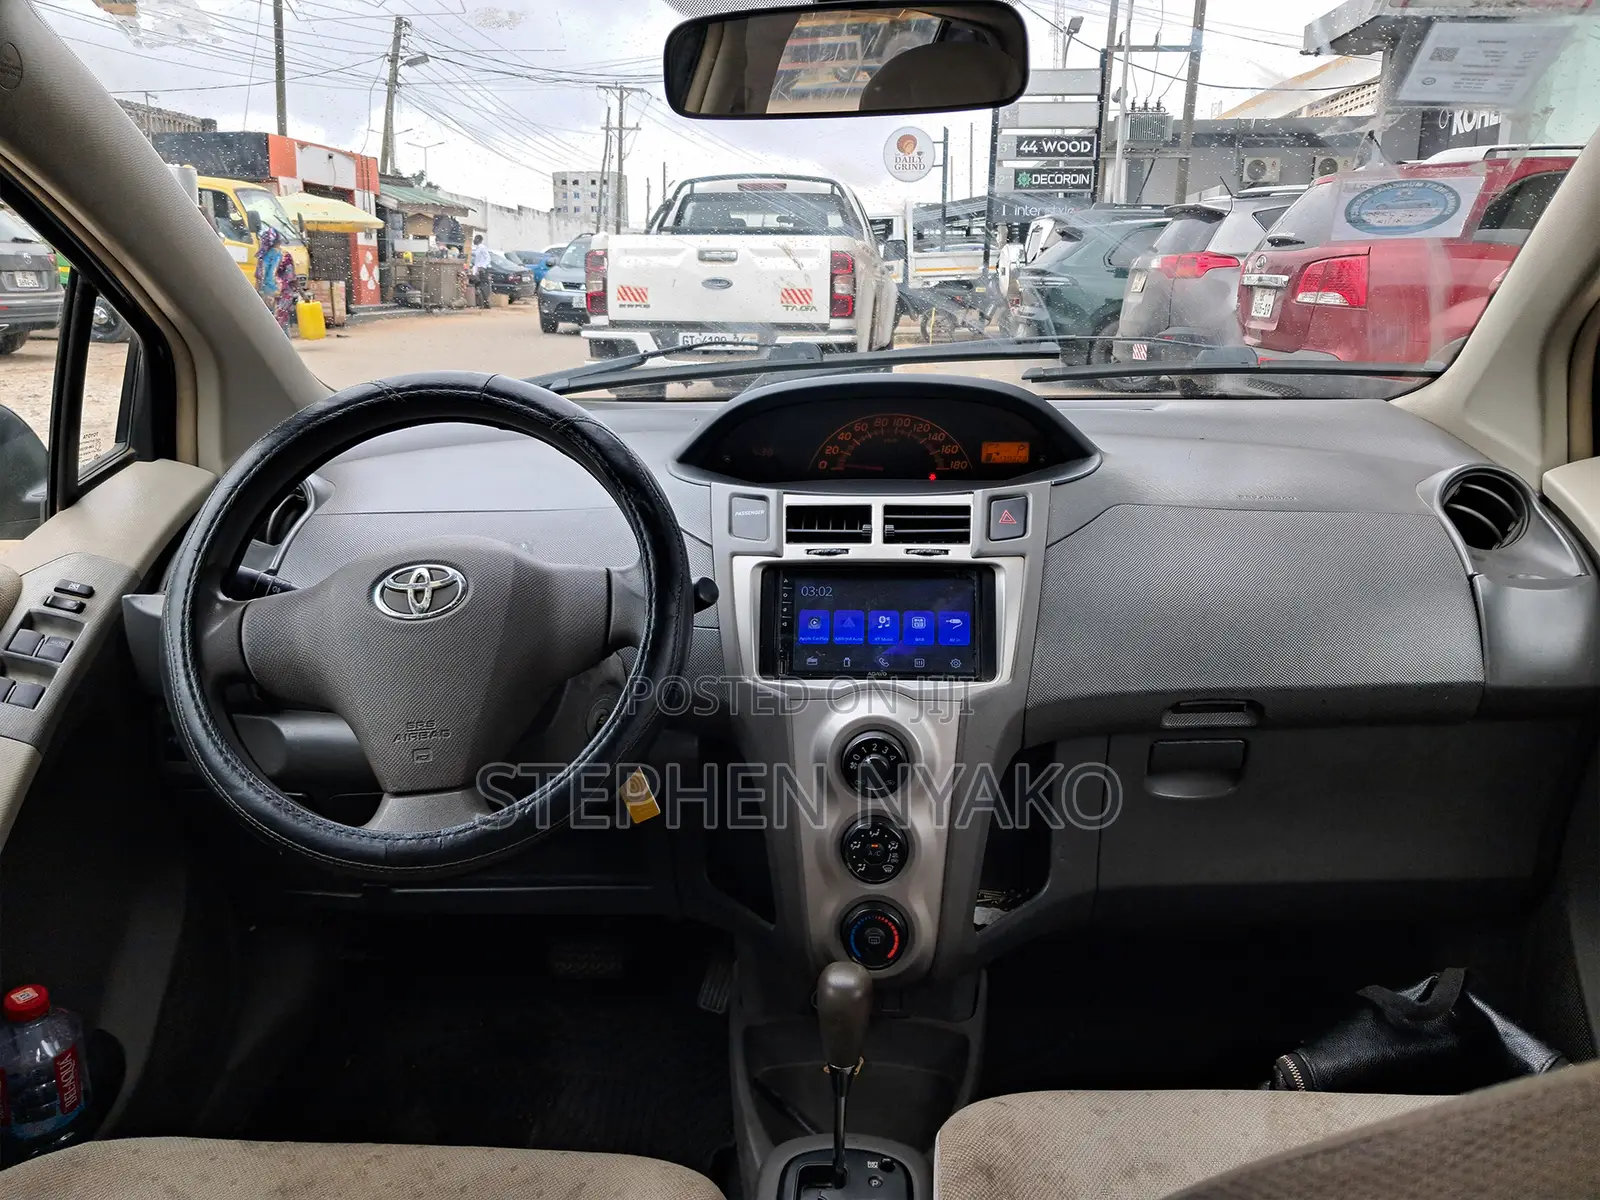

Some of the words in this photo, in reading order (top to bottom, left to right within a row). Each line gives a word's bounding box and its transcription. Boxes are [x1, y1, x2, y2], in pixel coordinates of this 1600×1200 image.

[1020, 140, 1038, 153] 44
[1042, 140, 1091, 153] WOOD
[894, 156, 923, 164] DAILY
[1032, 173, 1090, 185] DECORDIN
[874, 418, 888, 426] 80
[893, 418, 911, 426] 100
[854, 422, 868, 431] 60
[913, 424, 930, 432] 120
[838, 432, 851, 440] 40
[928, 432, 946, 441] 140
[825, 446, 839, 454] 20
[941, 445, 959, 453] 160
[818, 460, 827, 469] 0
[950, 461, 968, 469] 180
[801, 586, 833, 597] 03:02
[872, 743, 877, 751] 2
[882, 746, 889, 754] 3
